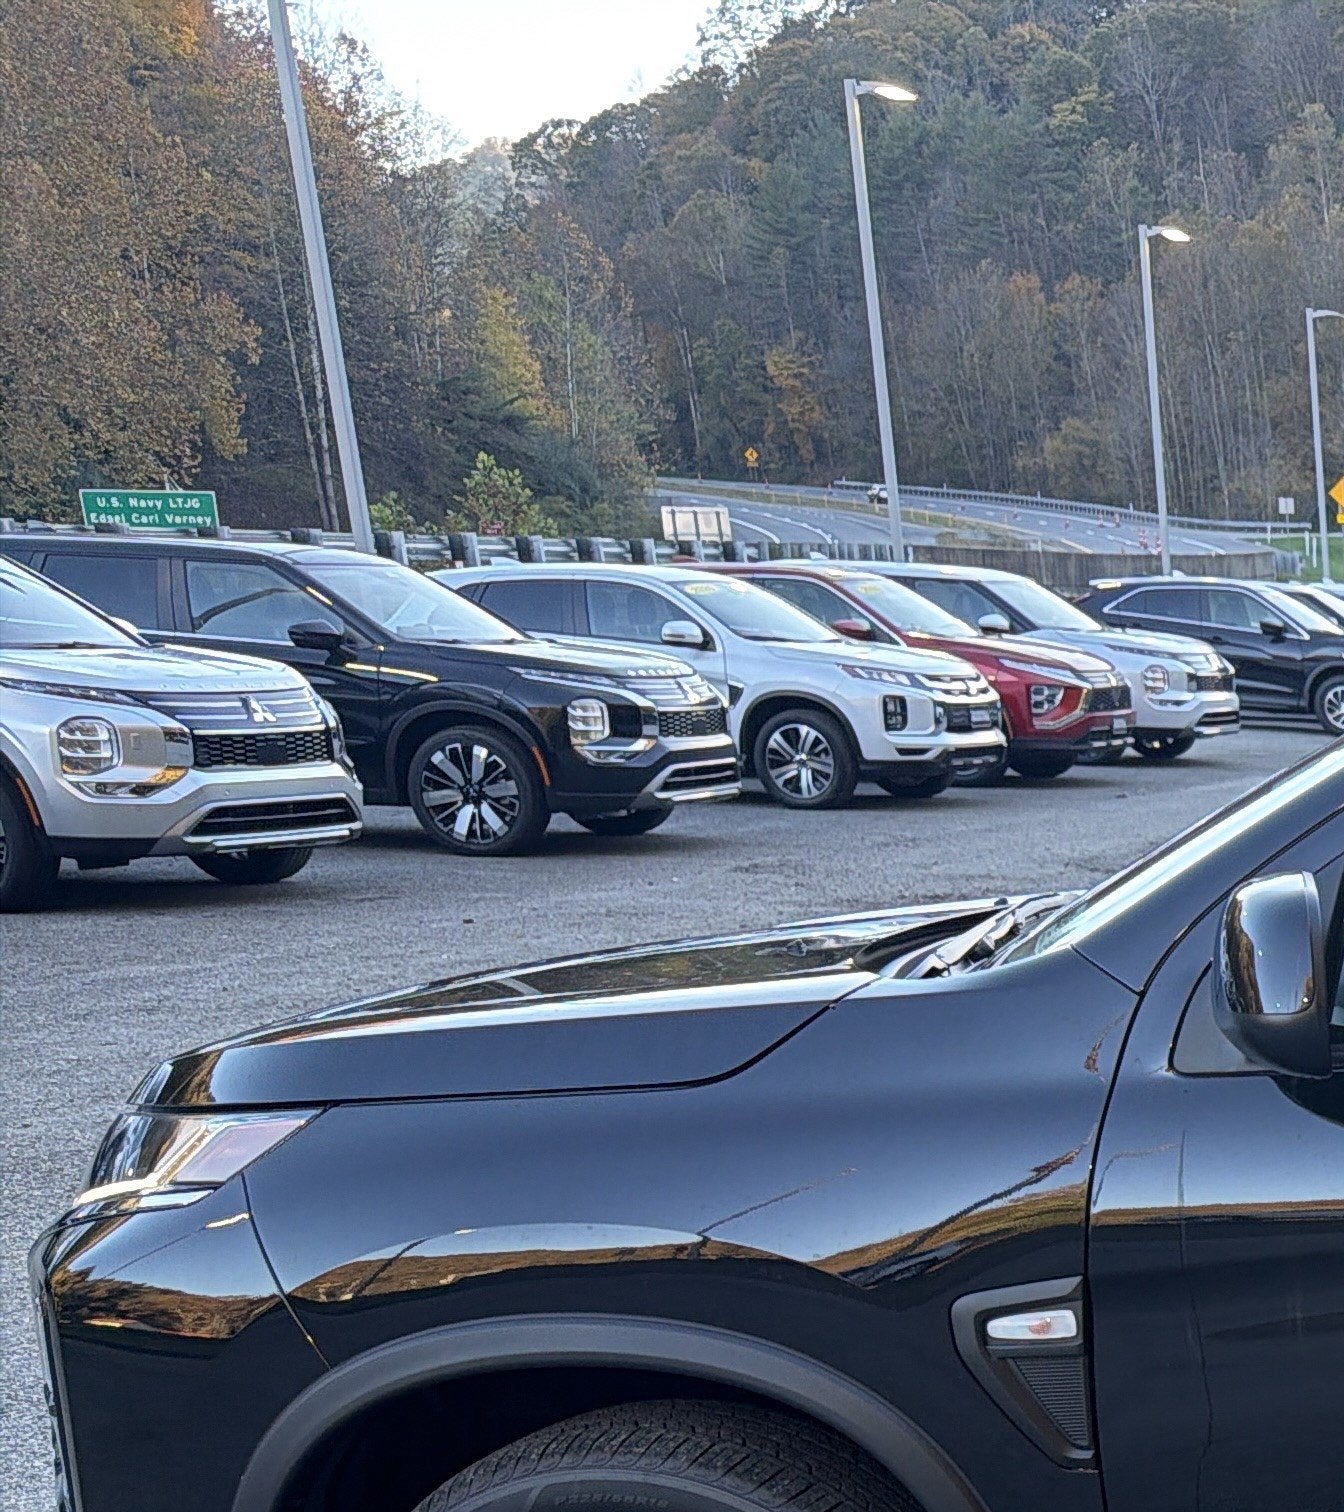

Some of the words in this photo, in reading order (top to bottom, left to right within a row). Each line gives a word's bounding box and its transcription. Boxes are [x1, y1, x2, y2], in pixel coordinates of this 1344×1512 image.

[96, 496, 124, 508] U.S.
[128, 497, 163, 511] Navy
[168, 497, 201, 509] LTJG
[131, 512, 160, 524] Carl
[164, 513, 212, 526] Varney
